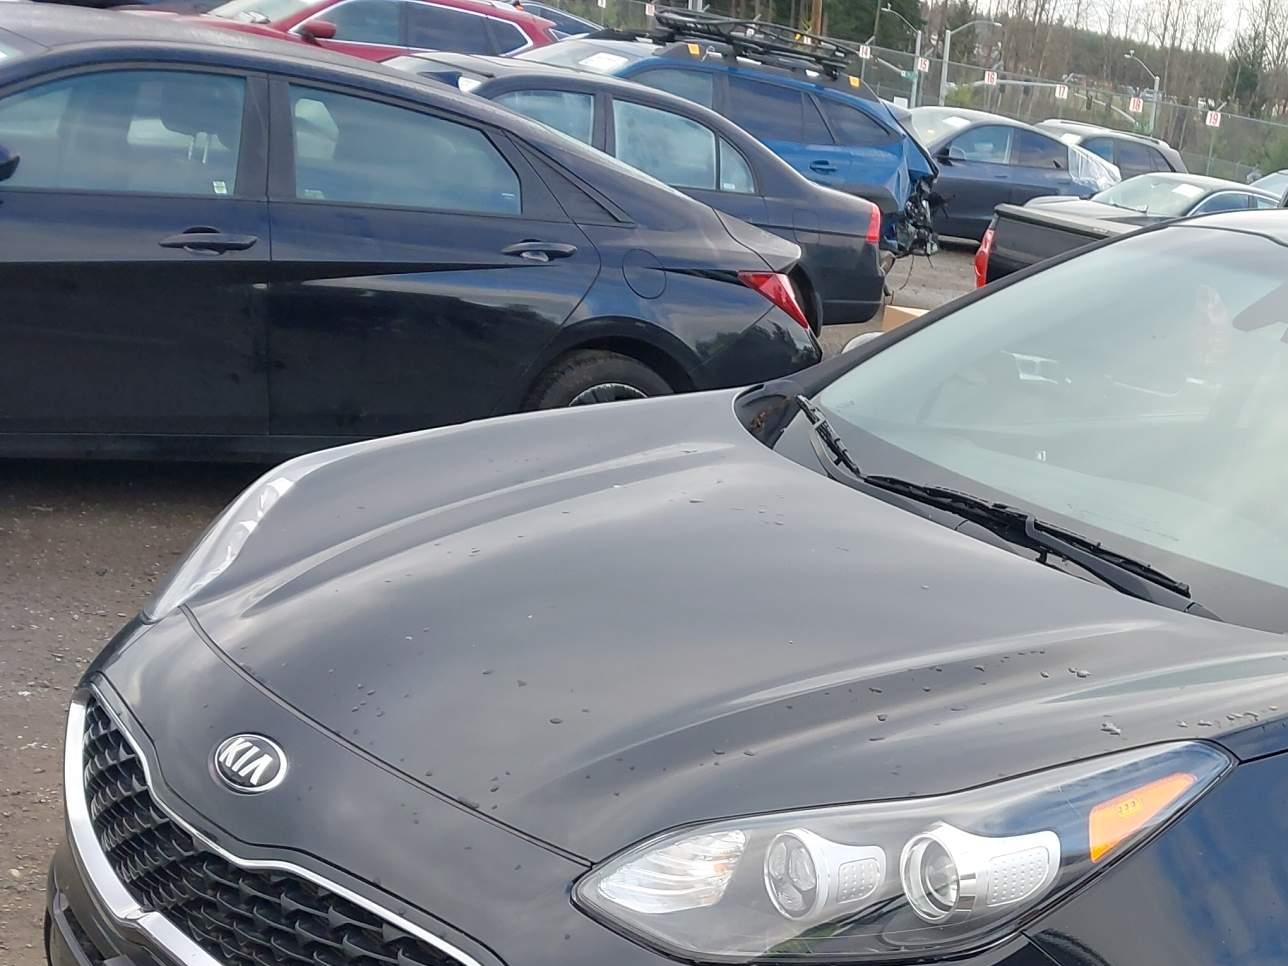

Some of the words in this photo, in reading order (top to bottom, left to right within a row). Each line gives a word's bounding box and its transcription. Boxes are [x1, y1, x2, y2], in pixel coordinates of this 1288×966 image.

[919, 58, 929, 71] 15
[1057, 86, 1067, 98] 17
[1208, 113, 1219, 126] 19
[218, 737, 273, 786] KIA
